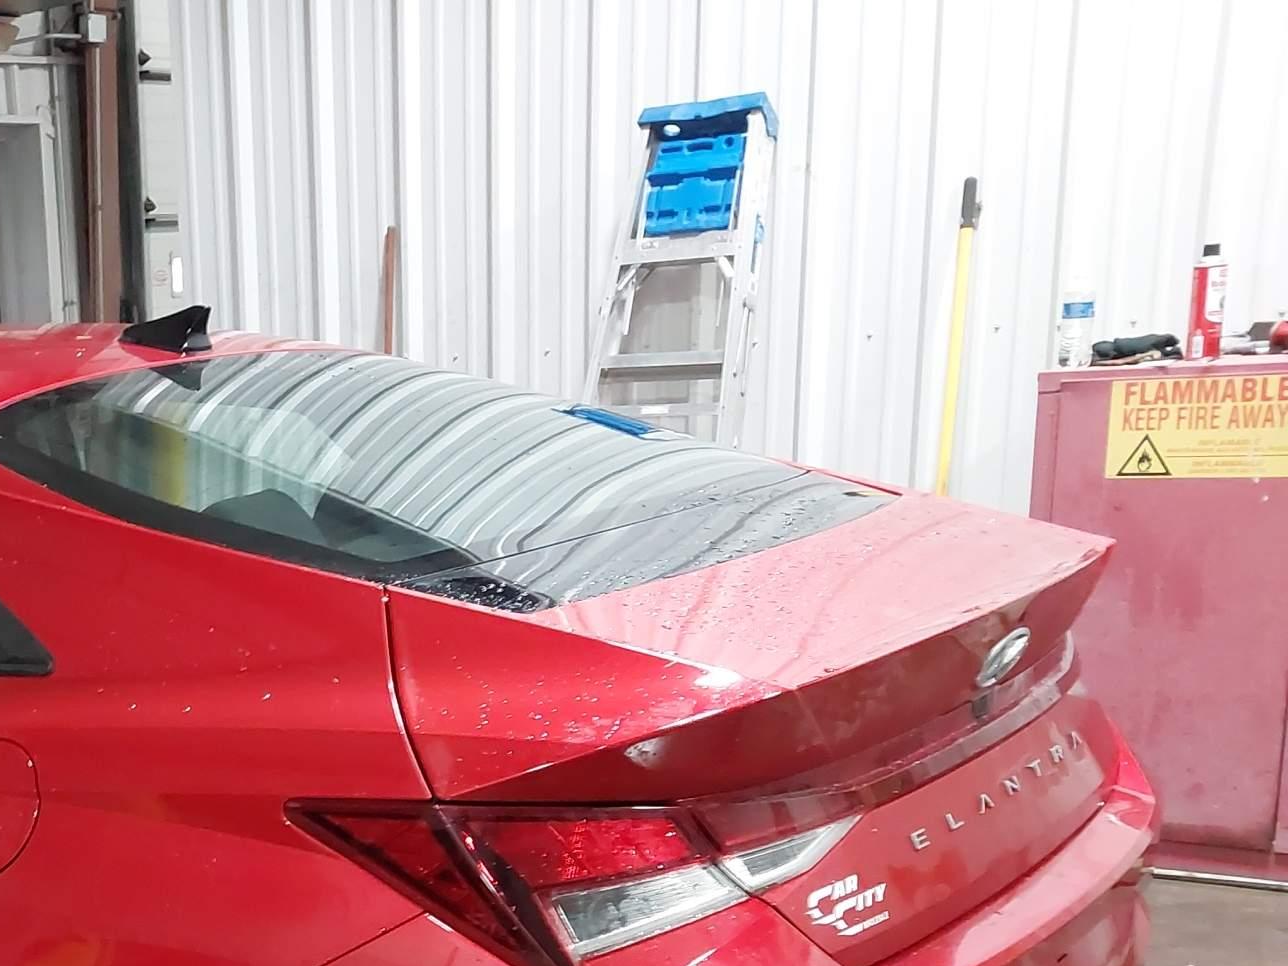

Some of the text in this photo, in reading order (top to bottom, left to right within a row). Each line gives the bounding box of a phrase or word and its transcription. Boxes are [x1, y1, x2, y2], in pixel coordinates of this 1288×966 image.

[1124, 377, 1288, 405] FLAMMABLE
[1122, 403, 1288, 431] KEEP FIRE AWAY
[910, 731, 1083, 851] ELANTRA
